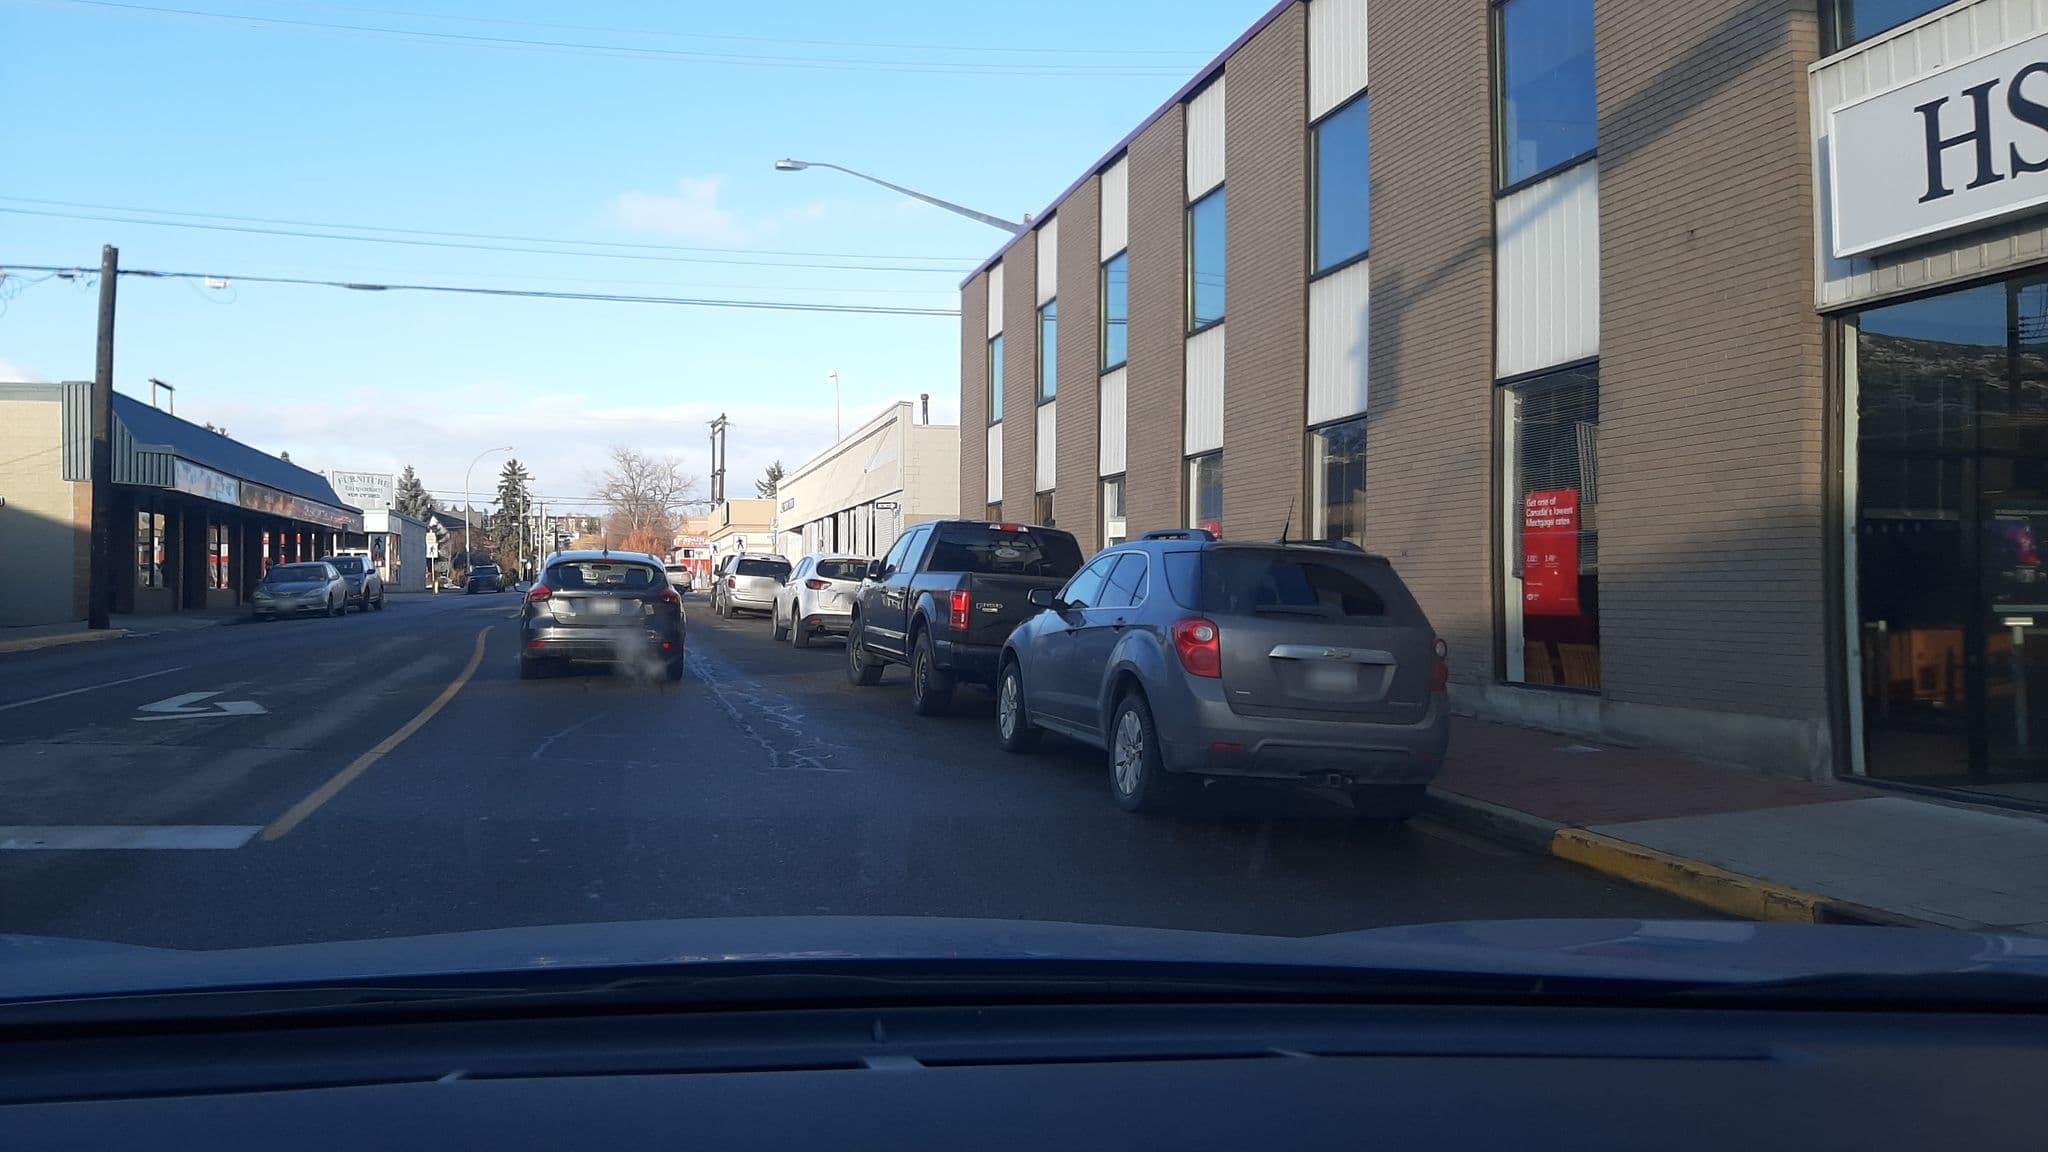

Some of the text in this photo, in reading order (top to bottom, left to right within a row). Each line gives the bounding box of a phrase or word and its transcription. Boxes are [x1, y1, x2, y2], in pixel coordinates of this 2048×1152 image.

[338, 475, 389, 487] FURNITURE
[1526, 499, 1537, 507] Get
[1549, 496, 1556, 505] of
[1526, 507, 1553, 517] Canada's
[1526, 518, 1554, 528] Mortgage
